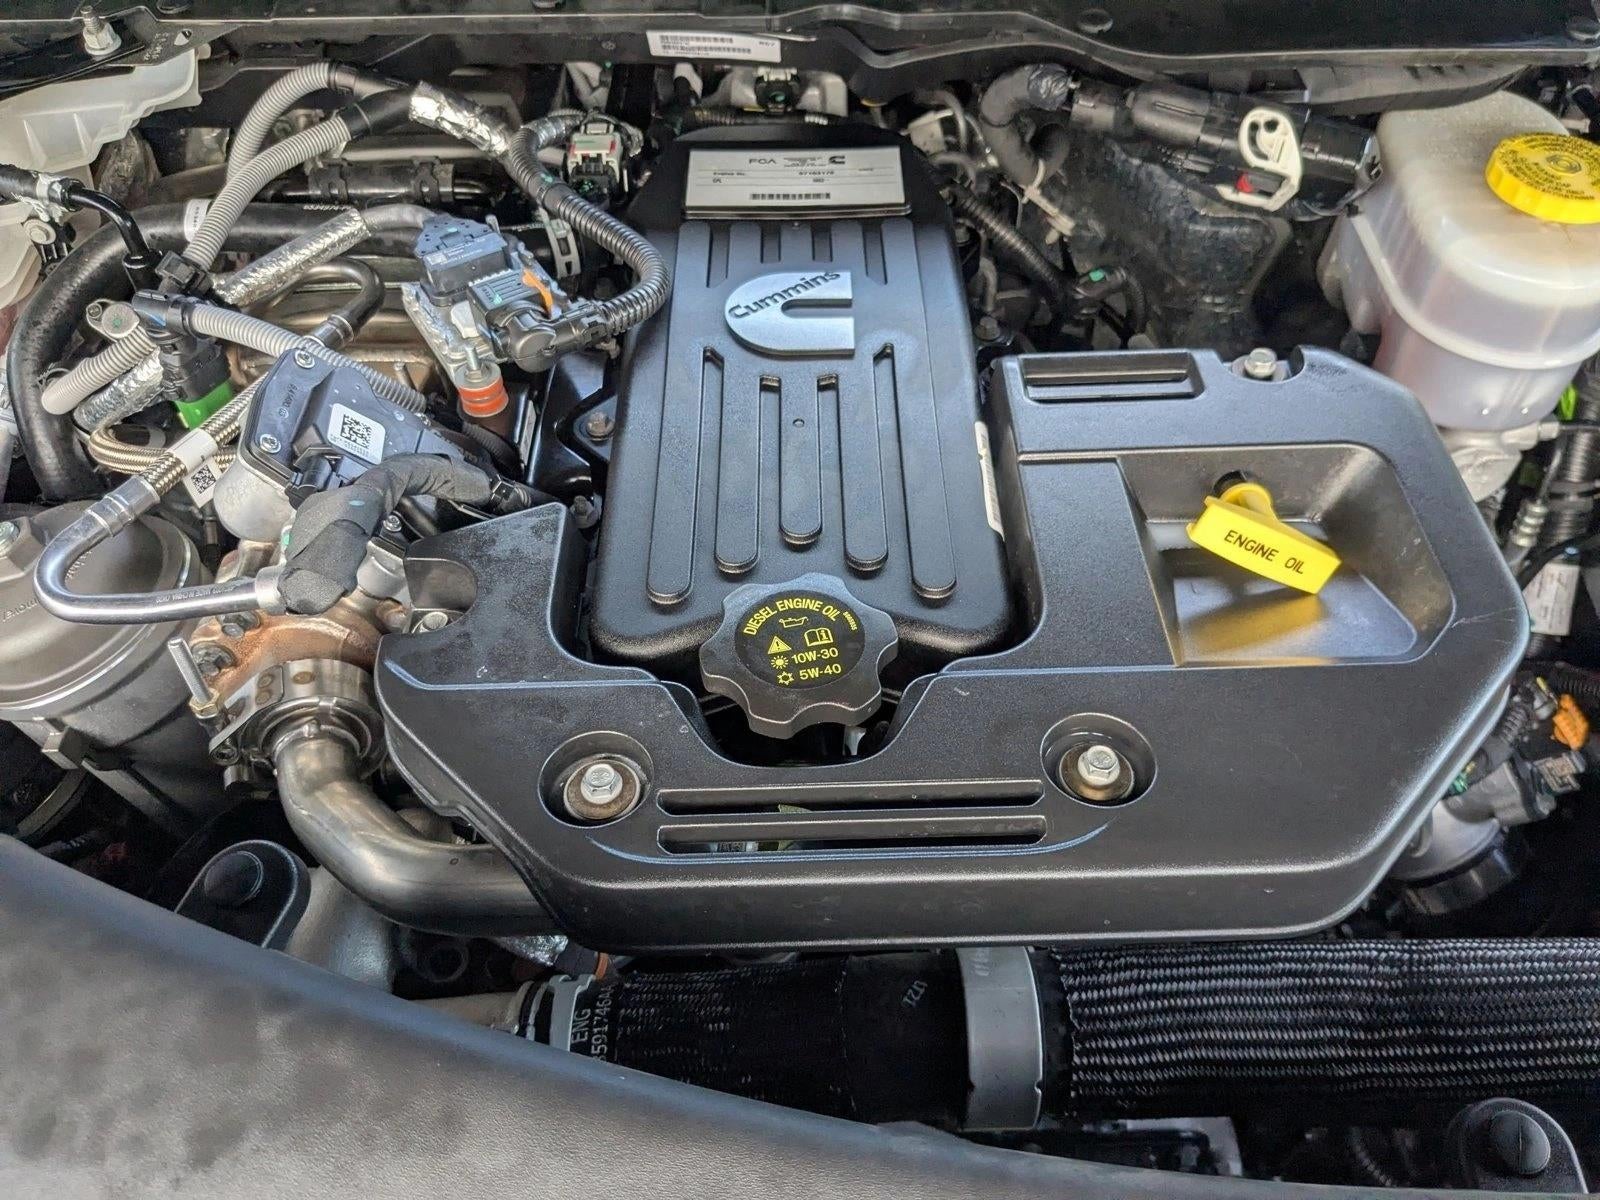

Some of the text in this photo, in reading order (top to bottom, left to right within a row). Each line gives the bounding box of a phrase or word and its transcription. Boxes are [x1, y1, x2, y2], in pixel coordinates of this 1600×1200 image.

[728, 271, 841, 319] Cummins
[1224, 529, 1305, 575] ENGINE OIL
[743, 606, 777, 636] DIESEL
[776, 598, 824, 612] ENGINE
[822, 605, 841, 622] OIL
[791, 647, 839, 665] 10W-30
[799, 663, 842, 681] 5W-40
[571, 1008, 592, 1044] ENG
